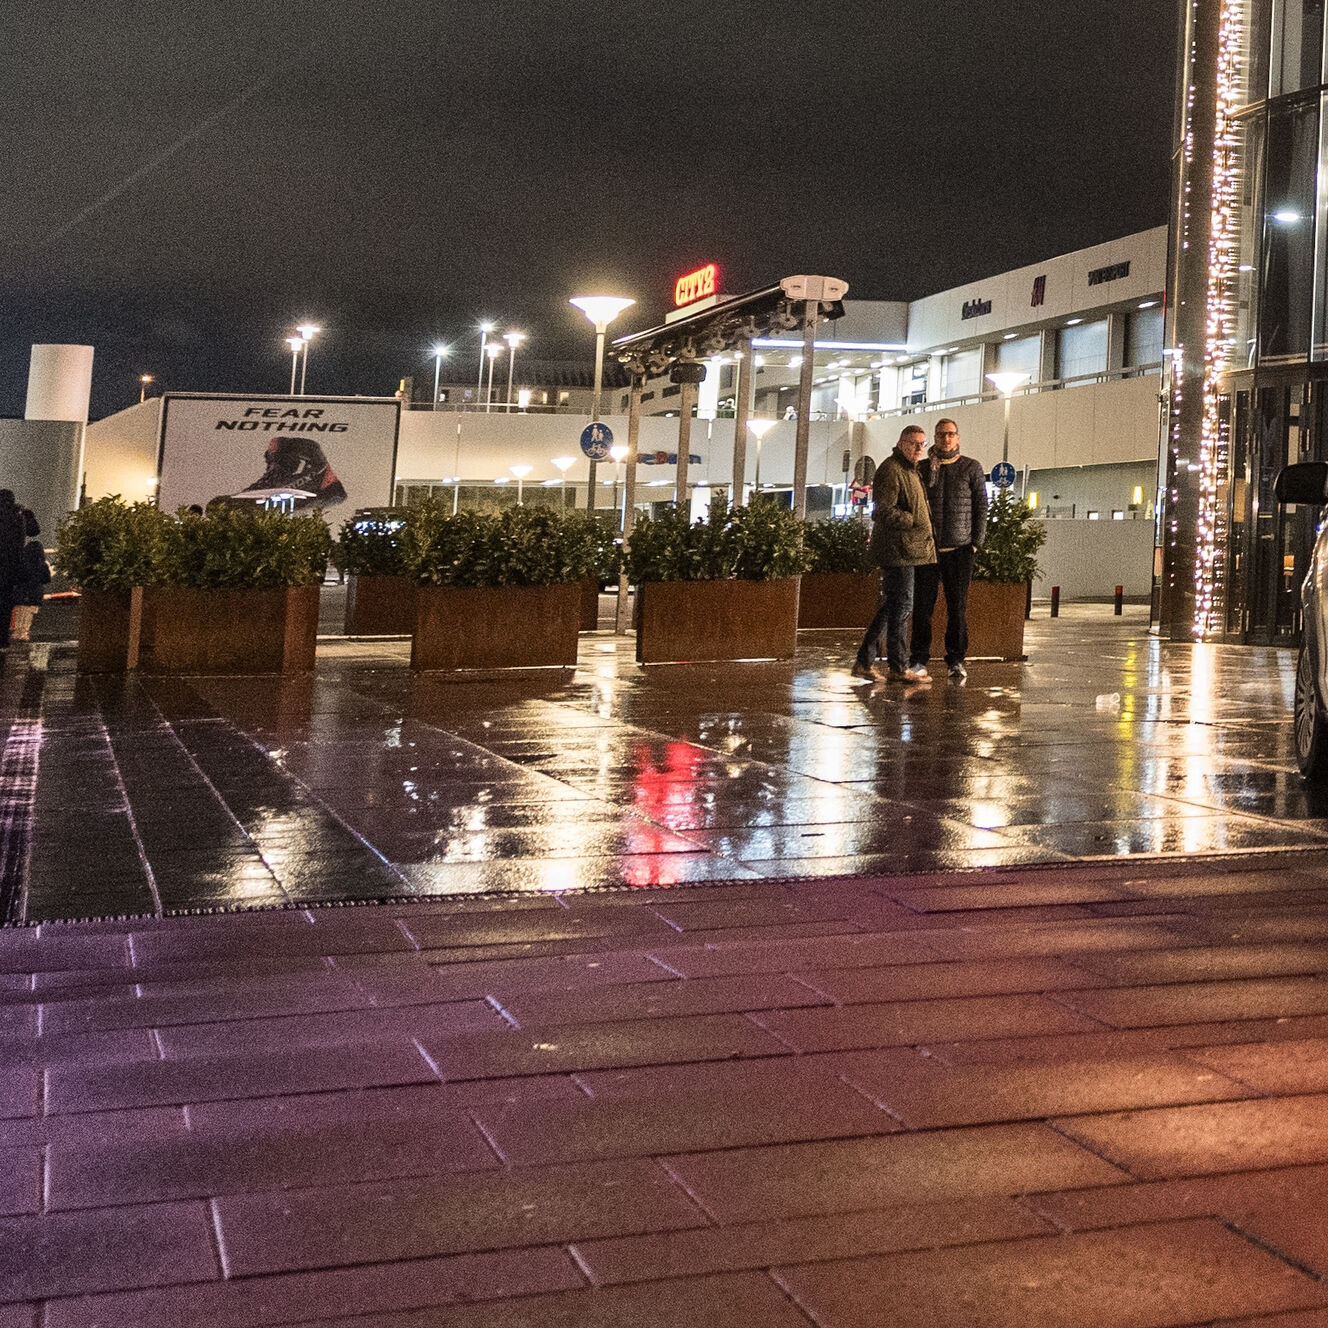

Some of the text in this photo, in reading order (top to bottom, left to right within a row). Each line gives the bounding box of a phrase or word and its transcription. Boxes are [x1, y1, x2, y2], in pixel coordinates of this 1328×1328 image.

[675, 264, 716, 307] CITY2
[243, 407, 325, 419] FEAR
[214, 420, 349, 433] NOTHING
